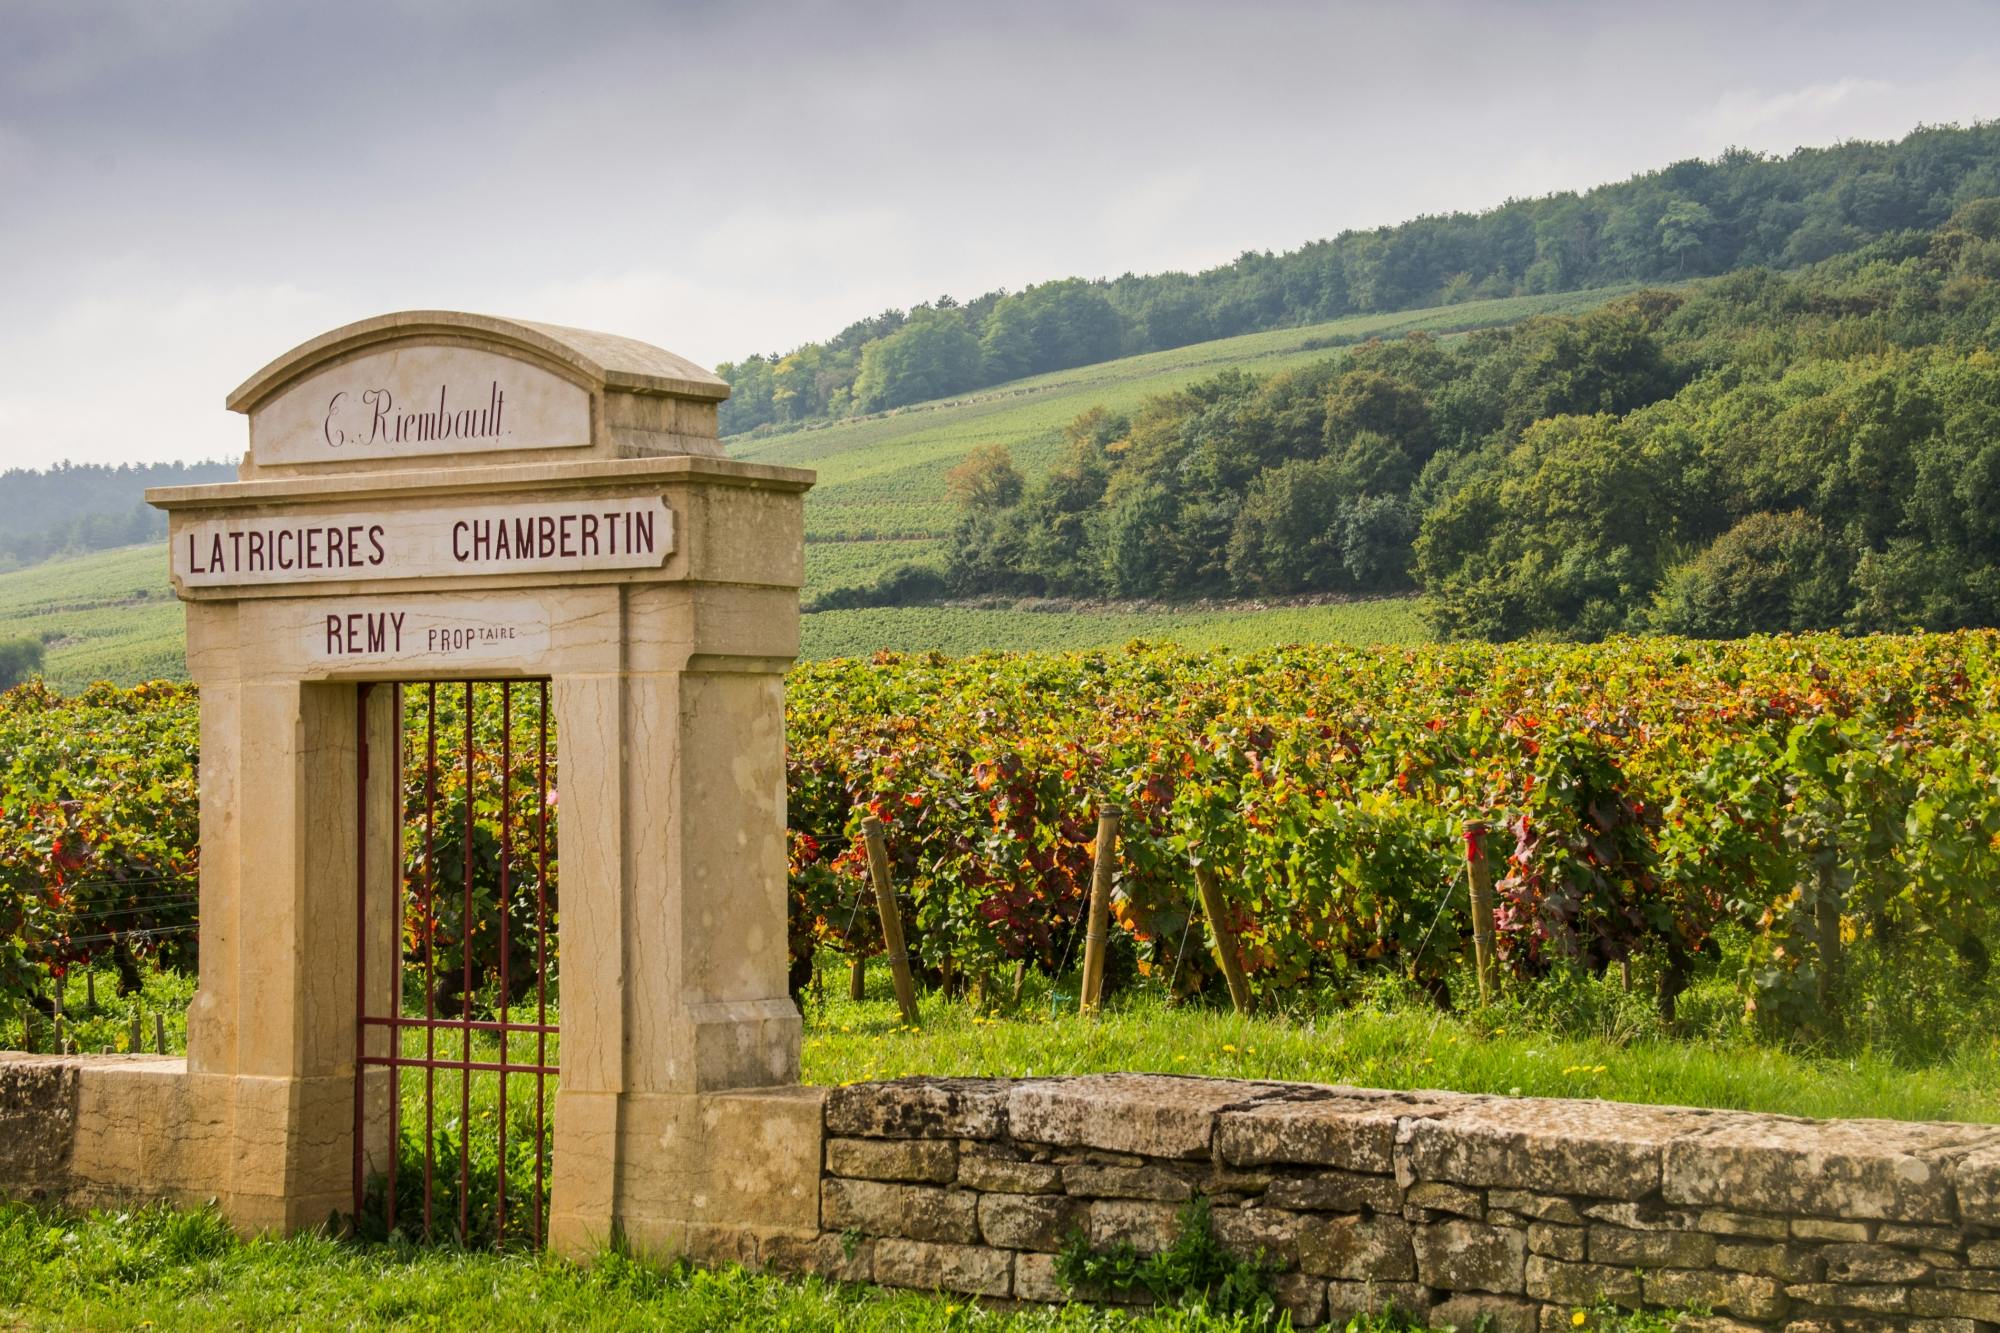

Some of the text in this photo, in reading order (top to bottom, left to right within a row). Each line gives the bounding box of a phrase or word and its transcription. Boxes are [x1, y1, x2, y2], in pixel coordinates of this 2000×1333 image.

[190, 511, 654, 573] LATRICIERES CHAMBERTIN
[327, 612, 405, 654] REMY
